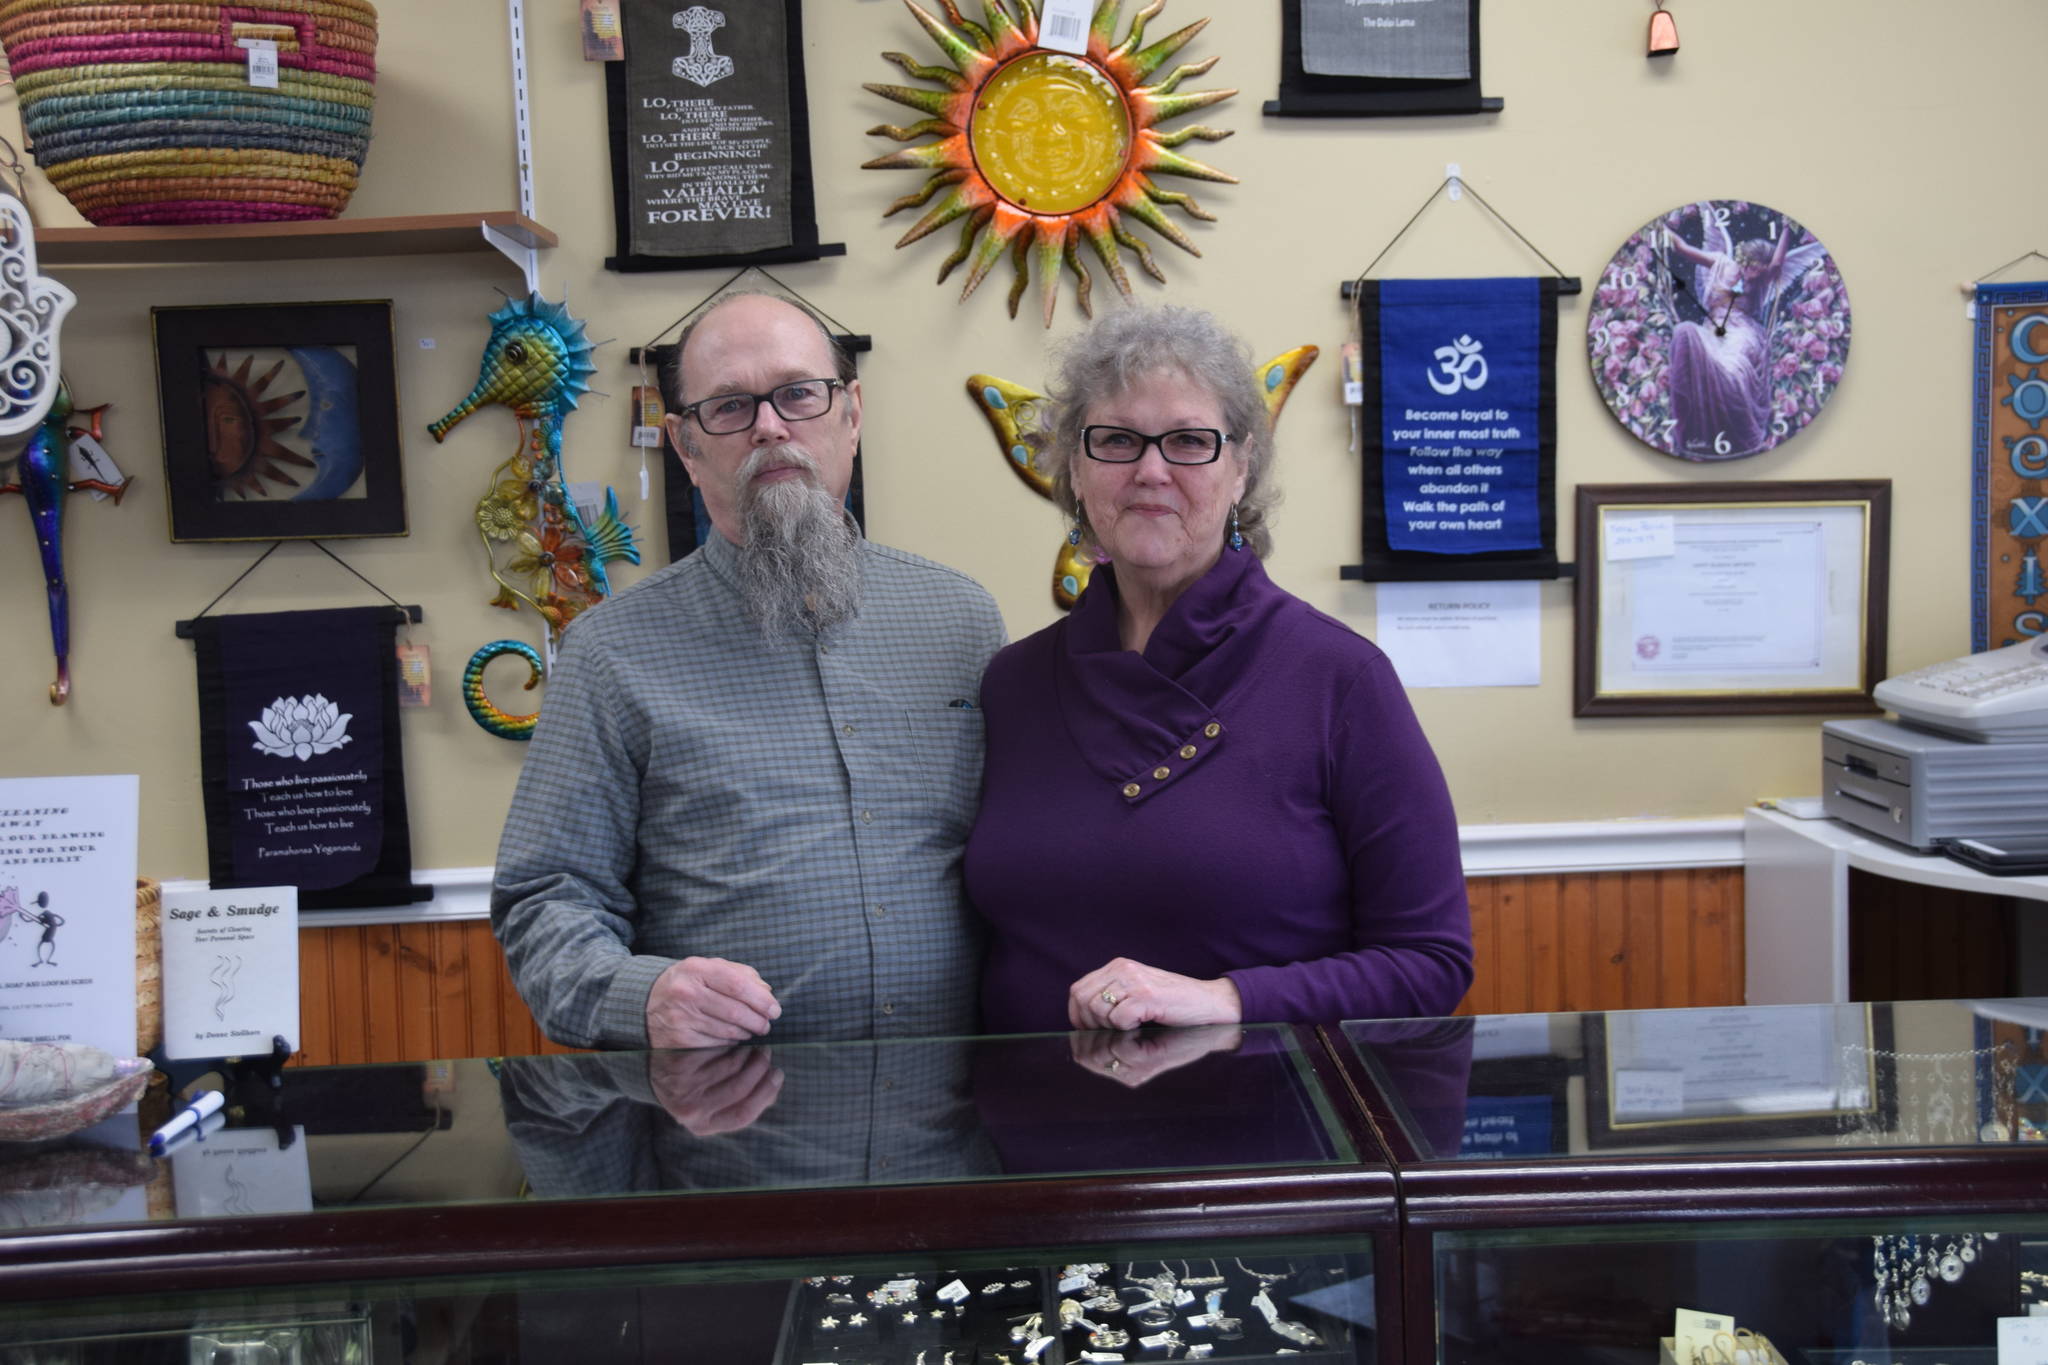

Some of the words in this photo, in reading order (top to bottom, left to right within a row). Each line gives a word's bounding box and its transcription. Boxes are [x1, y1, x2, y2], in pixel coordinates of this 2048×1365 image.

[671, 98, 714, 108] THERE
[685, 110, 728, 119] THERE
[670, 132, 721, 141] THERE
[674, 150, 761, 161] BEGINNING!
[663, 184, 765, 198] VALHALLA!
[647, 206, 772, 224] FOREVER!
[1703, 207, 1731, 227] 12
[1768, 221, 1778, 240] 1
[1812, 258, 1825, 274] 2
[1609, 271, 1638, 289] 10
[1594, 326, 1610, 347] 9
[1811, 371, 1825, 394] 4
[1405, 409, 1458, 421] Become
[1461, 409, 1493, 423] loyal
[1495, 409, 1509, 421] to
[1772, 413, 1789, 436] 5
[1392, 428, 1421, 441] your
[1424, 428, 1456, 440] inner
[1458, 428, 1489, 440] most
[1491, 428, 1520, 439] truth
[1662, 419, 1678, 445] 7
[1714, 431, 1732, 455] 6
[1410, 446, 1450, 457] Follow
[1452, 446, 1472, 457] the
[1475, 448, 1503, 459] way
[1408, 464, 1443, 476] when
[1445, 464, 1461, 476] all
[1463, 464, 1503, 476] others
[1419, 483, 1478, 494] abandon
[1480, 483, 1490, 494] it
[1403, 501, 1434, 513] Walk
[1436, 501, 1457, 512] the
[1460, 501, 1489, 514] path
[1492, 500, 1506, 512] of
[1408, 520, 1436, 532] your
[1439, 520, 1465, 530] own
[1467, 519, 1503, 530] heart
[242, 778, 274, 790] Those
[275, 776, 294, 787] who
[295, 774, 310, 784] live
[312, 770, 368, 786] passionately
[260, 790, 292, 803] Teach
[292, 792, 304, 800] us
[304, 788, 323, 799] how
[324, 789, 335, 797] to
[336, 786, 354, 796] love
[244, 808, 276, 820] Those
[277, 806, 296, 816] who
[297, 804, 316, 815] love
[316, 800, 372, 818] passionately
[264, 821, 296, 834] Teach
[298, 823, 308, 831] us
[309, 820, 328, 830] how
[328, 820, 339, 829] to
[340, 817, 354, 828] live
[28, 846, 54, 854] FOR
[60, 845, 96, 853] YOUR
[313, 842, 361, 856] Yogananda
[33, 856, 82, 864] SPIRIT
[170, 907, 202, 921] Sage
[207, 906, 221, 918] &
[226, 904, 280, 918] Smudge
[210, 934, 236, 942] Personal
[238, 934, 255, 942] Space
[195, 1032, 204, 1040] by
